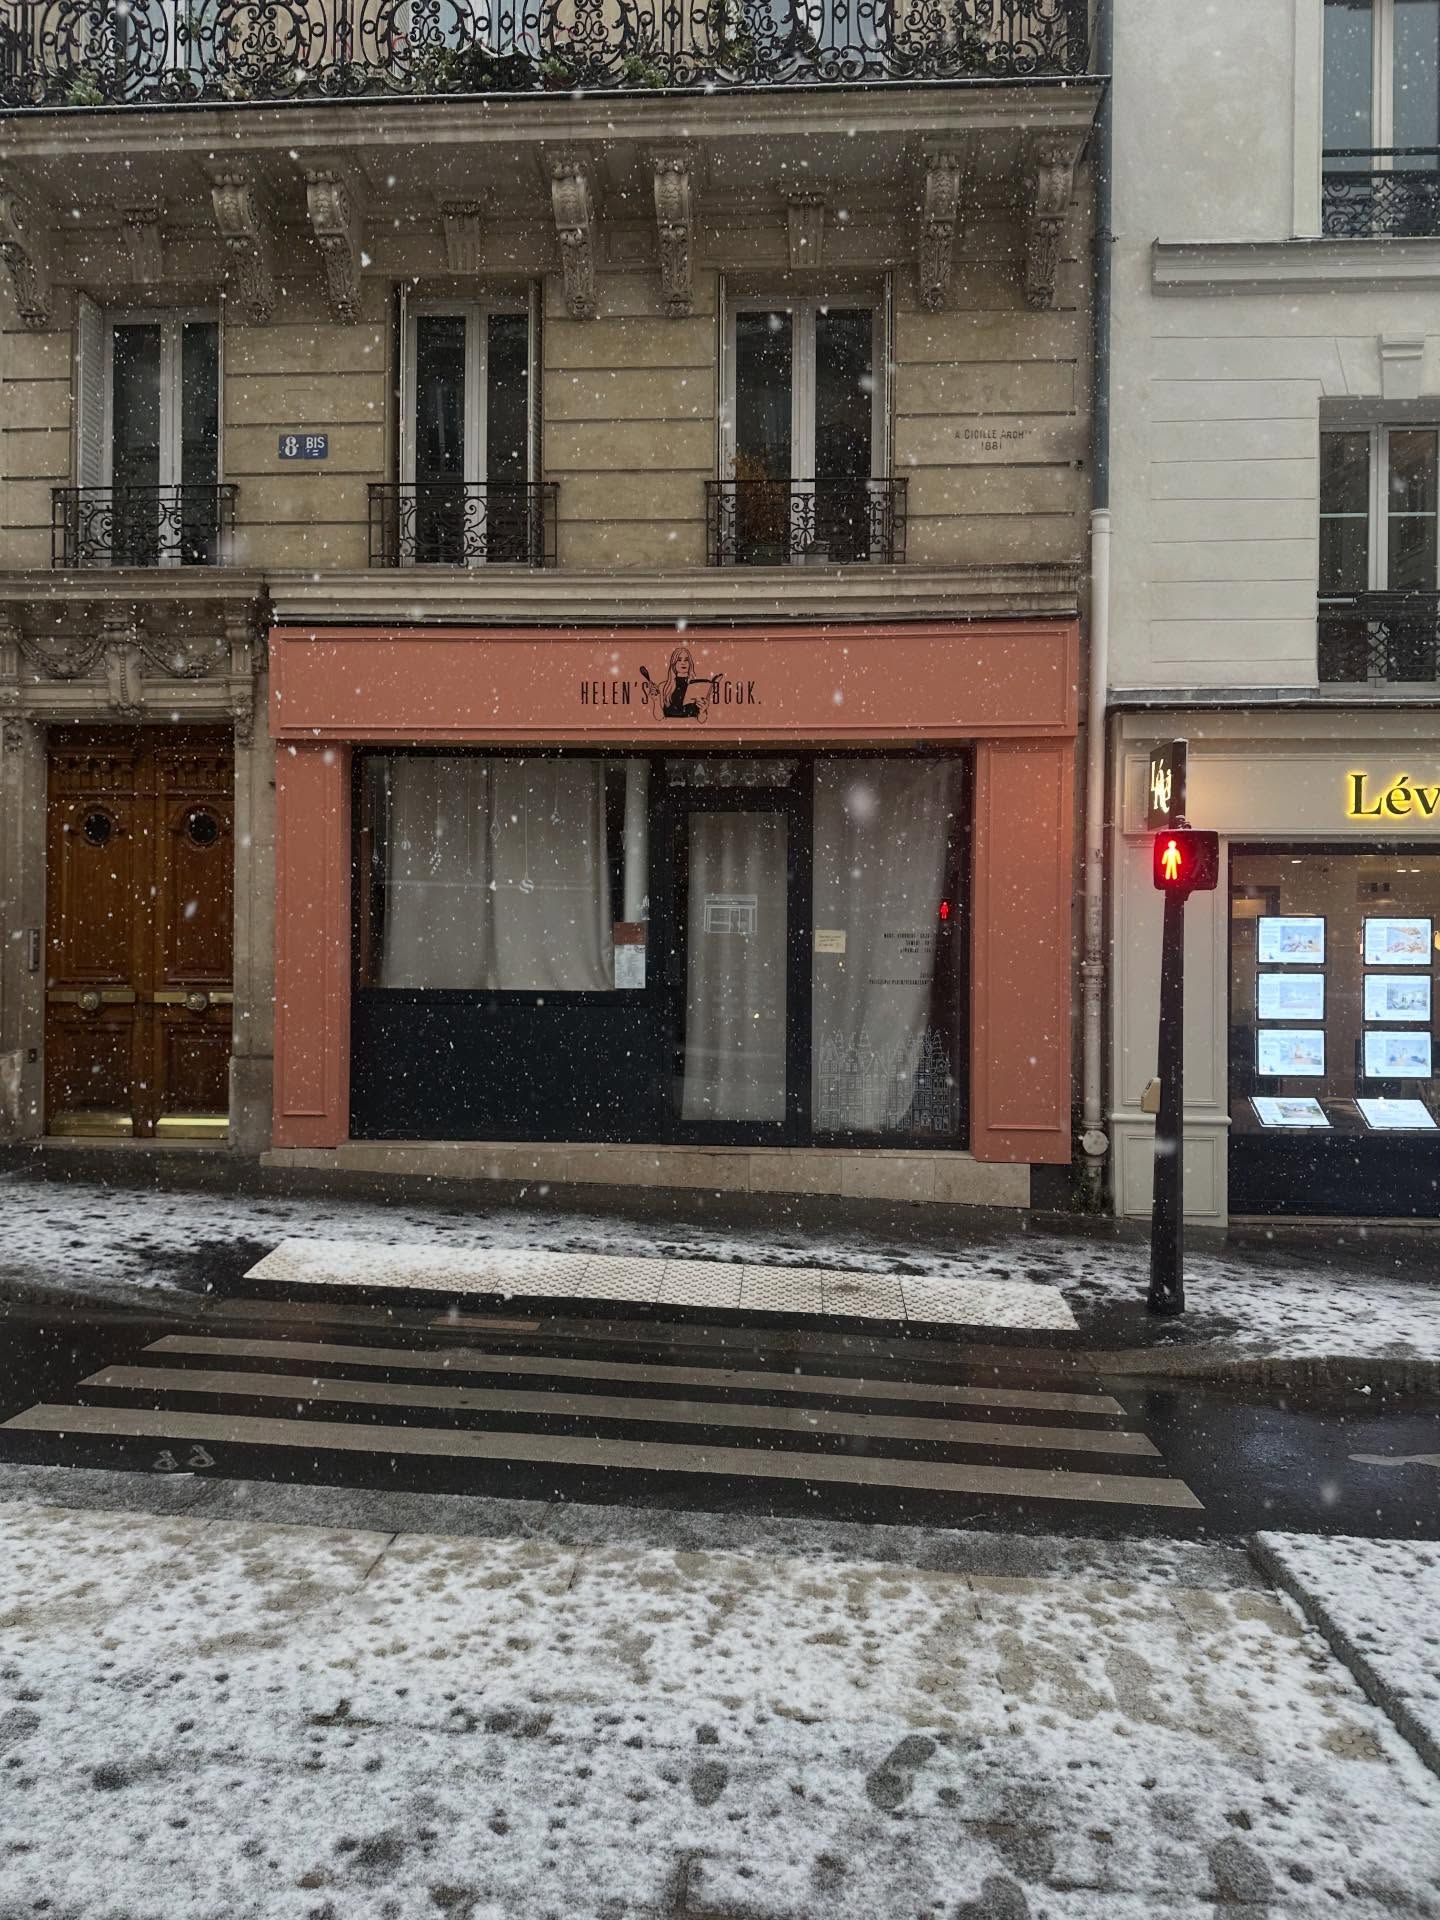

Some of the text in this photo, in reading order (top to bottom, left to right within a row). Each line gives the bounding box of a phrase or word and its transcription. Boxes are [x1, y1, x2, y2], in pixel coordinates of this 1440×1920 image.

[285, 436, 325, 456] 8 BIS
[581, 681, 650, 705] HELEN'S
